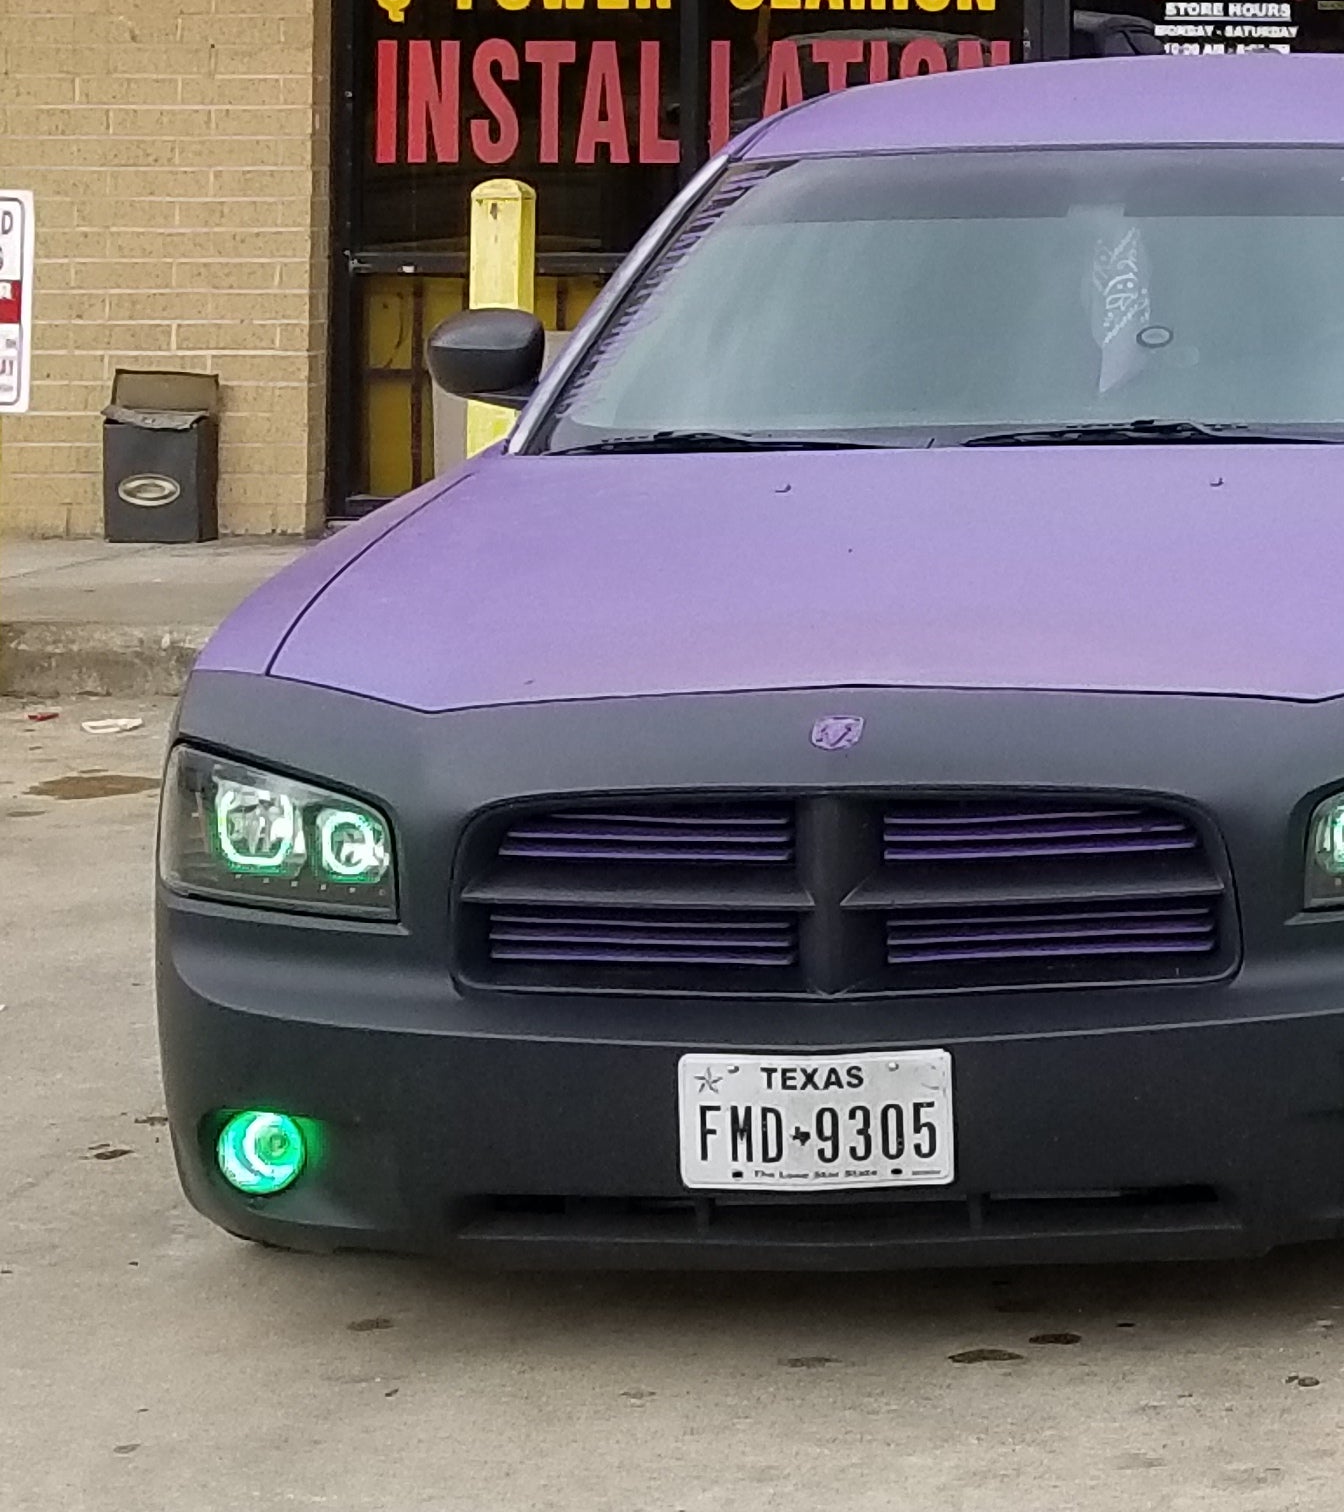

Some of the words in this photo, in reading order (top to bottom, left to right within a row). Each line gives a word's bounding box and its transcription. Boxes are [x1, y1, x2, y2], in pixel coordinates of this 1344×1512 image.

[1164, 2, 1224, 17] STORE
[1228, 3, 1291, 18] HOURS
[761, 1065, 865, 1091] TEXAS
